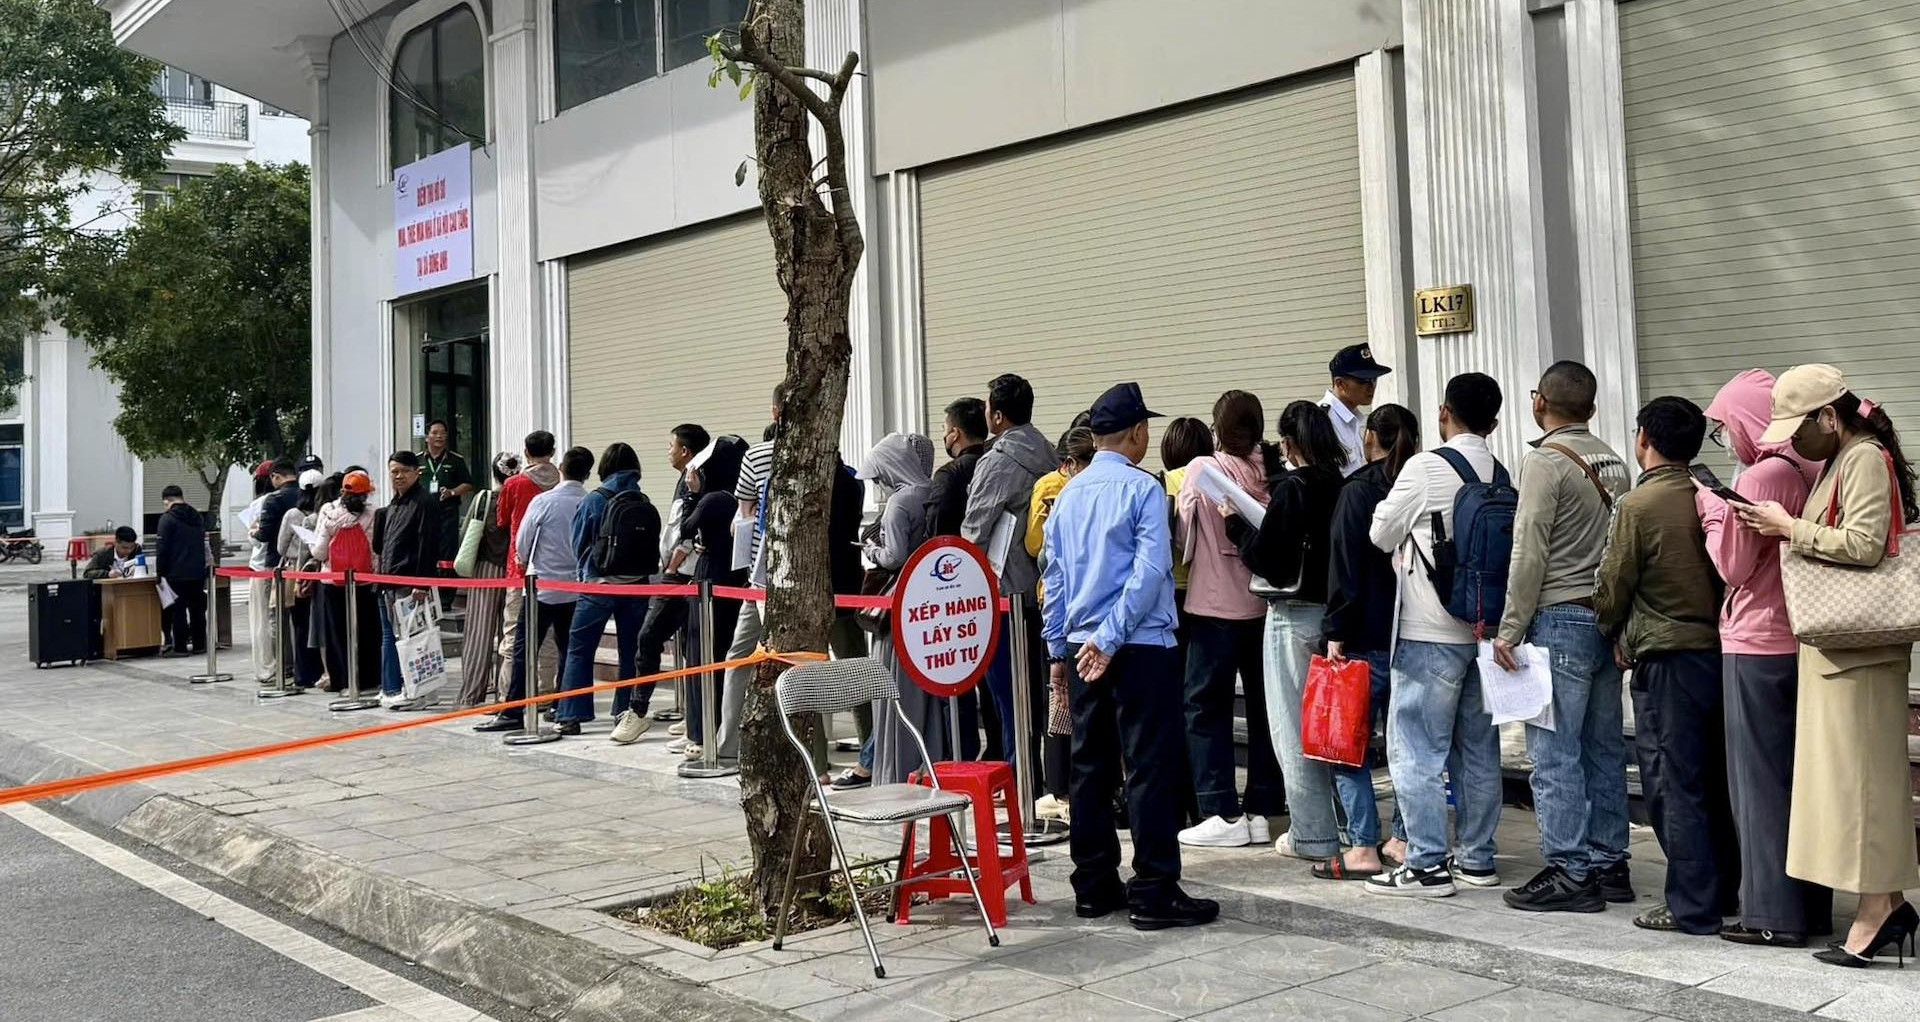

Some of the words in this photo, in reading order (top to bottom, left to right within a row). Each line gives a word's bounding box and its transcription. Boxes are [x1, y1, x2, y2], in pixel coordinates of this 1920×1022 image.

[1421, 294, 1464, 314] LK17
[908, 600, 940, 623] XẾP
[945, 596, 986, 616] HÀNG
[923, 622, 952, 645] LẤY
[957, 617, 977, 639] SỐ
[924, 648, 957, 670] THỨ
[959, 644, 979, 664] TỰ
